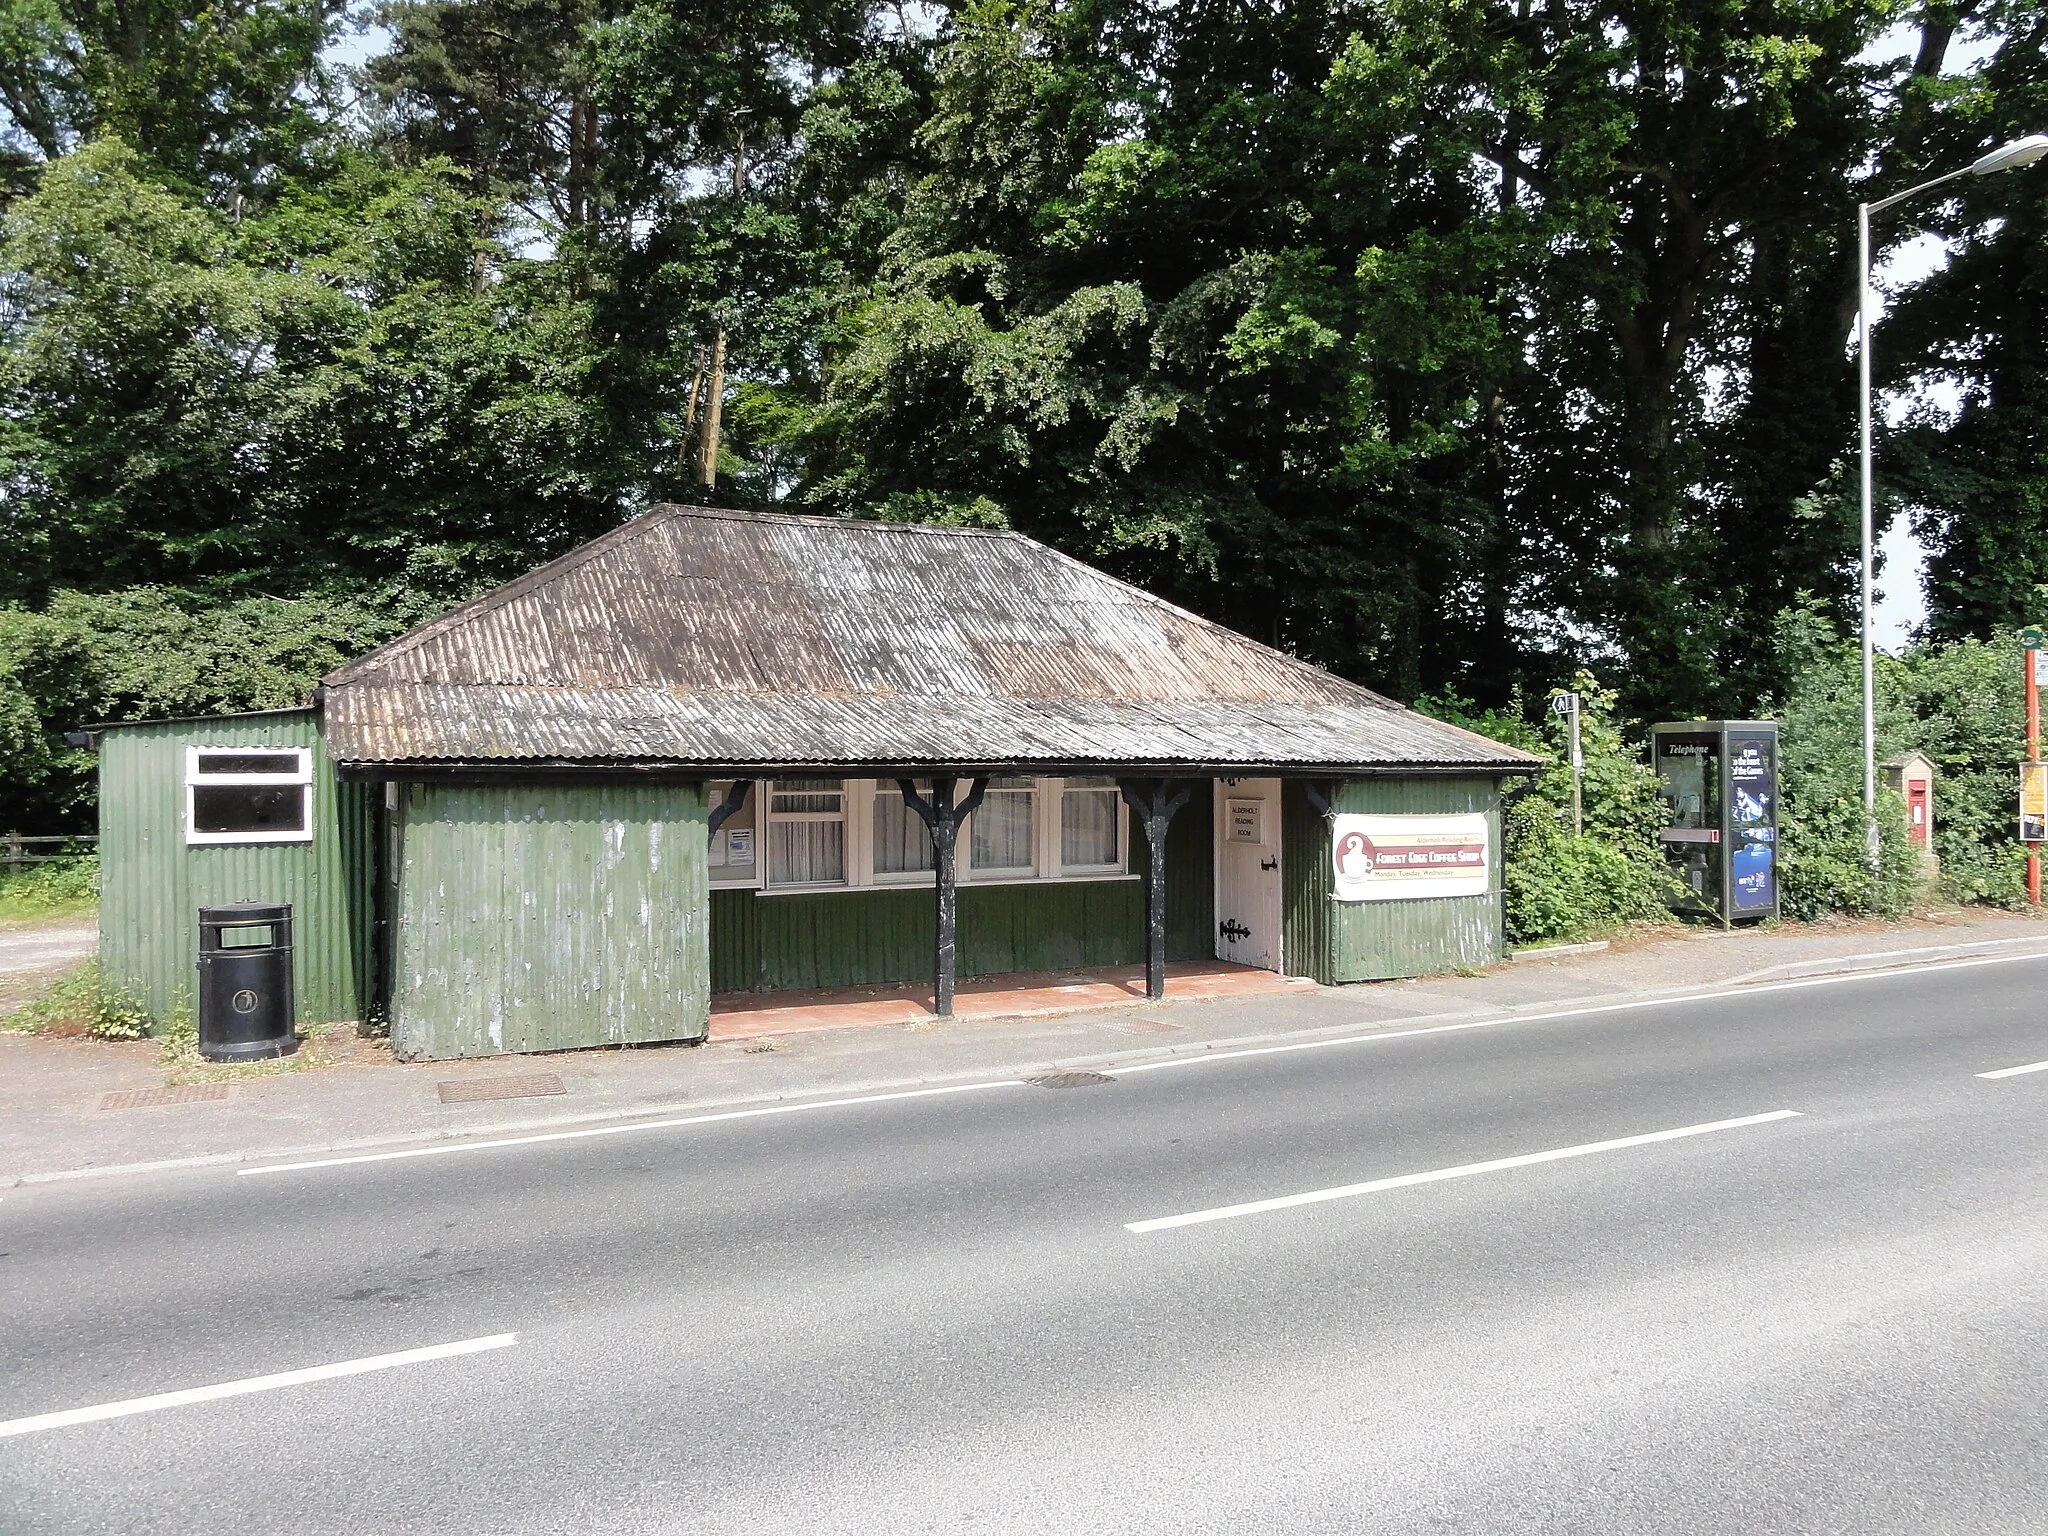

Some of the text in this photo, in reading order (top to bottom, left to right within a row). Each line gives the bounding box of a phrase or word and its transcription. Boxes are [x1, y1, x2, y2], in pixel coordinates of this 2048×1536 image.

[1669, 744, 1709, 755] Telephone
[1738, 756, 1746, 765] the
[1738, 766, 1746, 775] the
